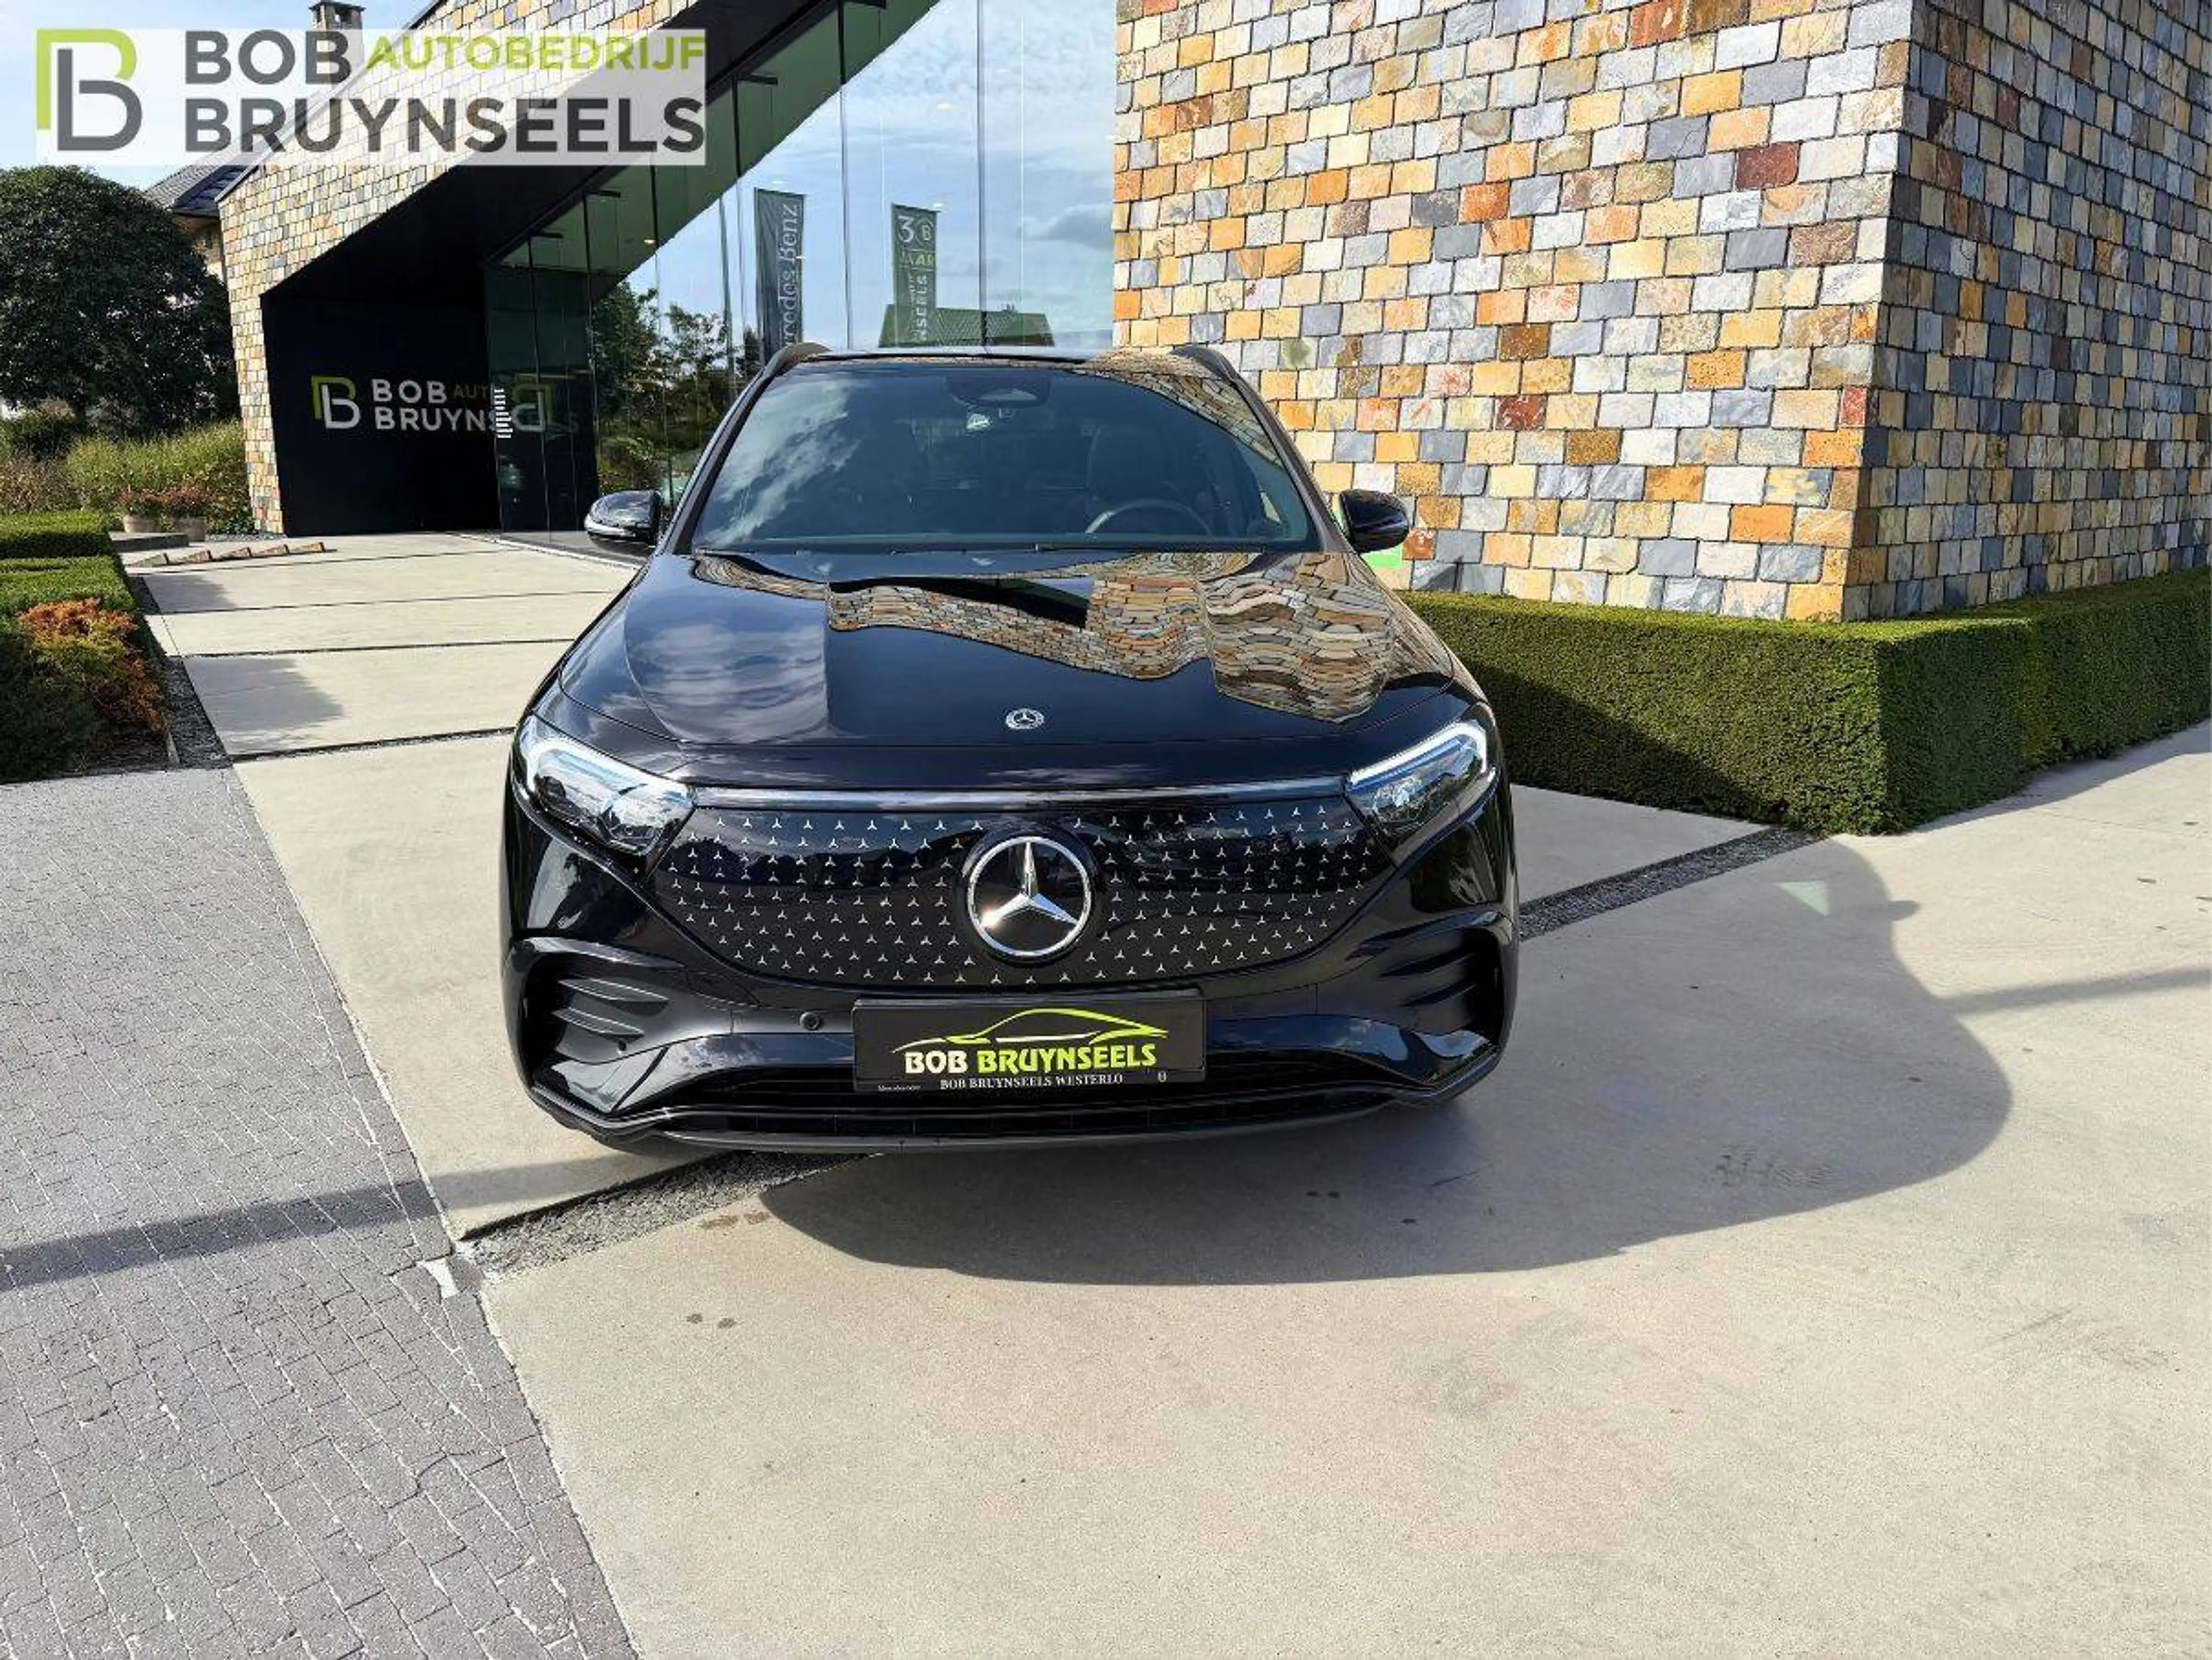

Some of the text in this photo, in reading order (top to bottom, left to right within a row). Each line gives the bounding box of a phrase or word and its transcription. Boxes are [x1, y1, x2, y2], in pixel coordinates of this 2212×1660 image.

[372, 379, 447, 403] BOB
[905, 1044, 1157, 1074] BOB BRUYNSEELS
[940, 1073, 1123, 1090] BOB BRUYNSEELS WESTERLO
